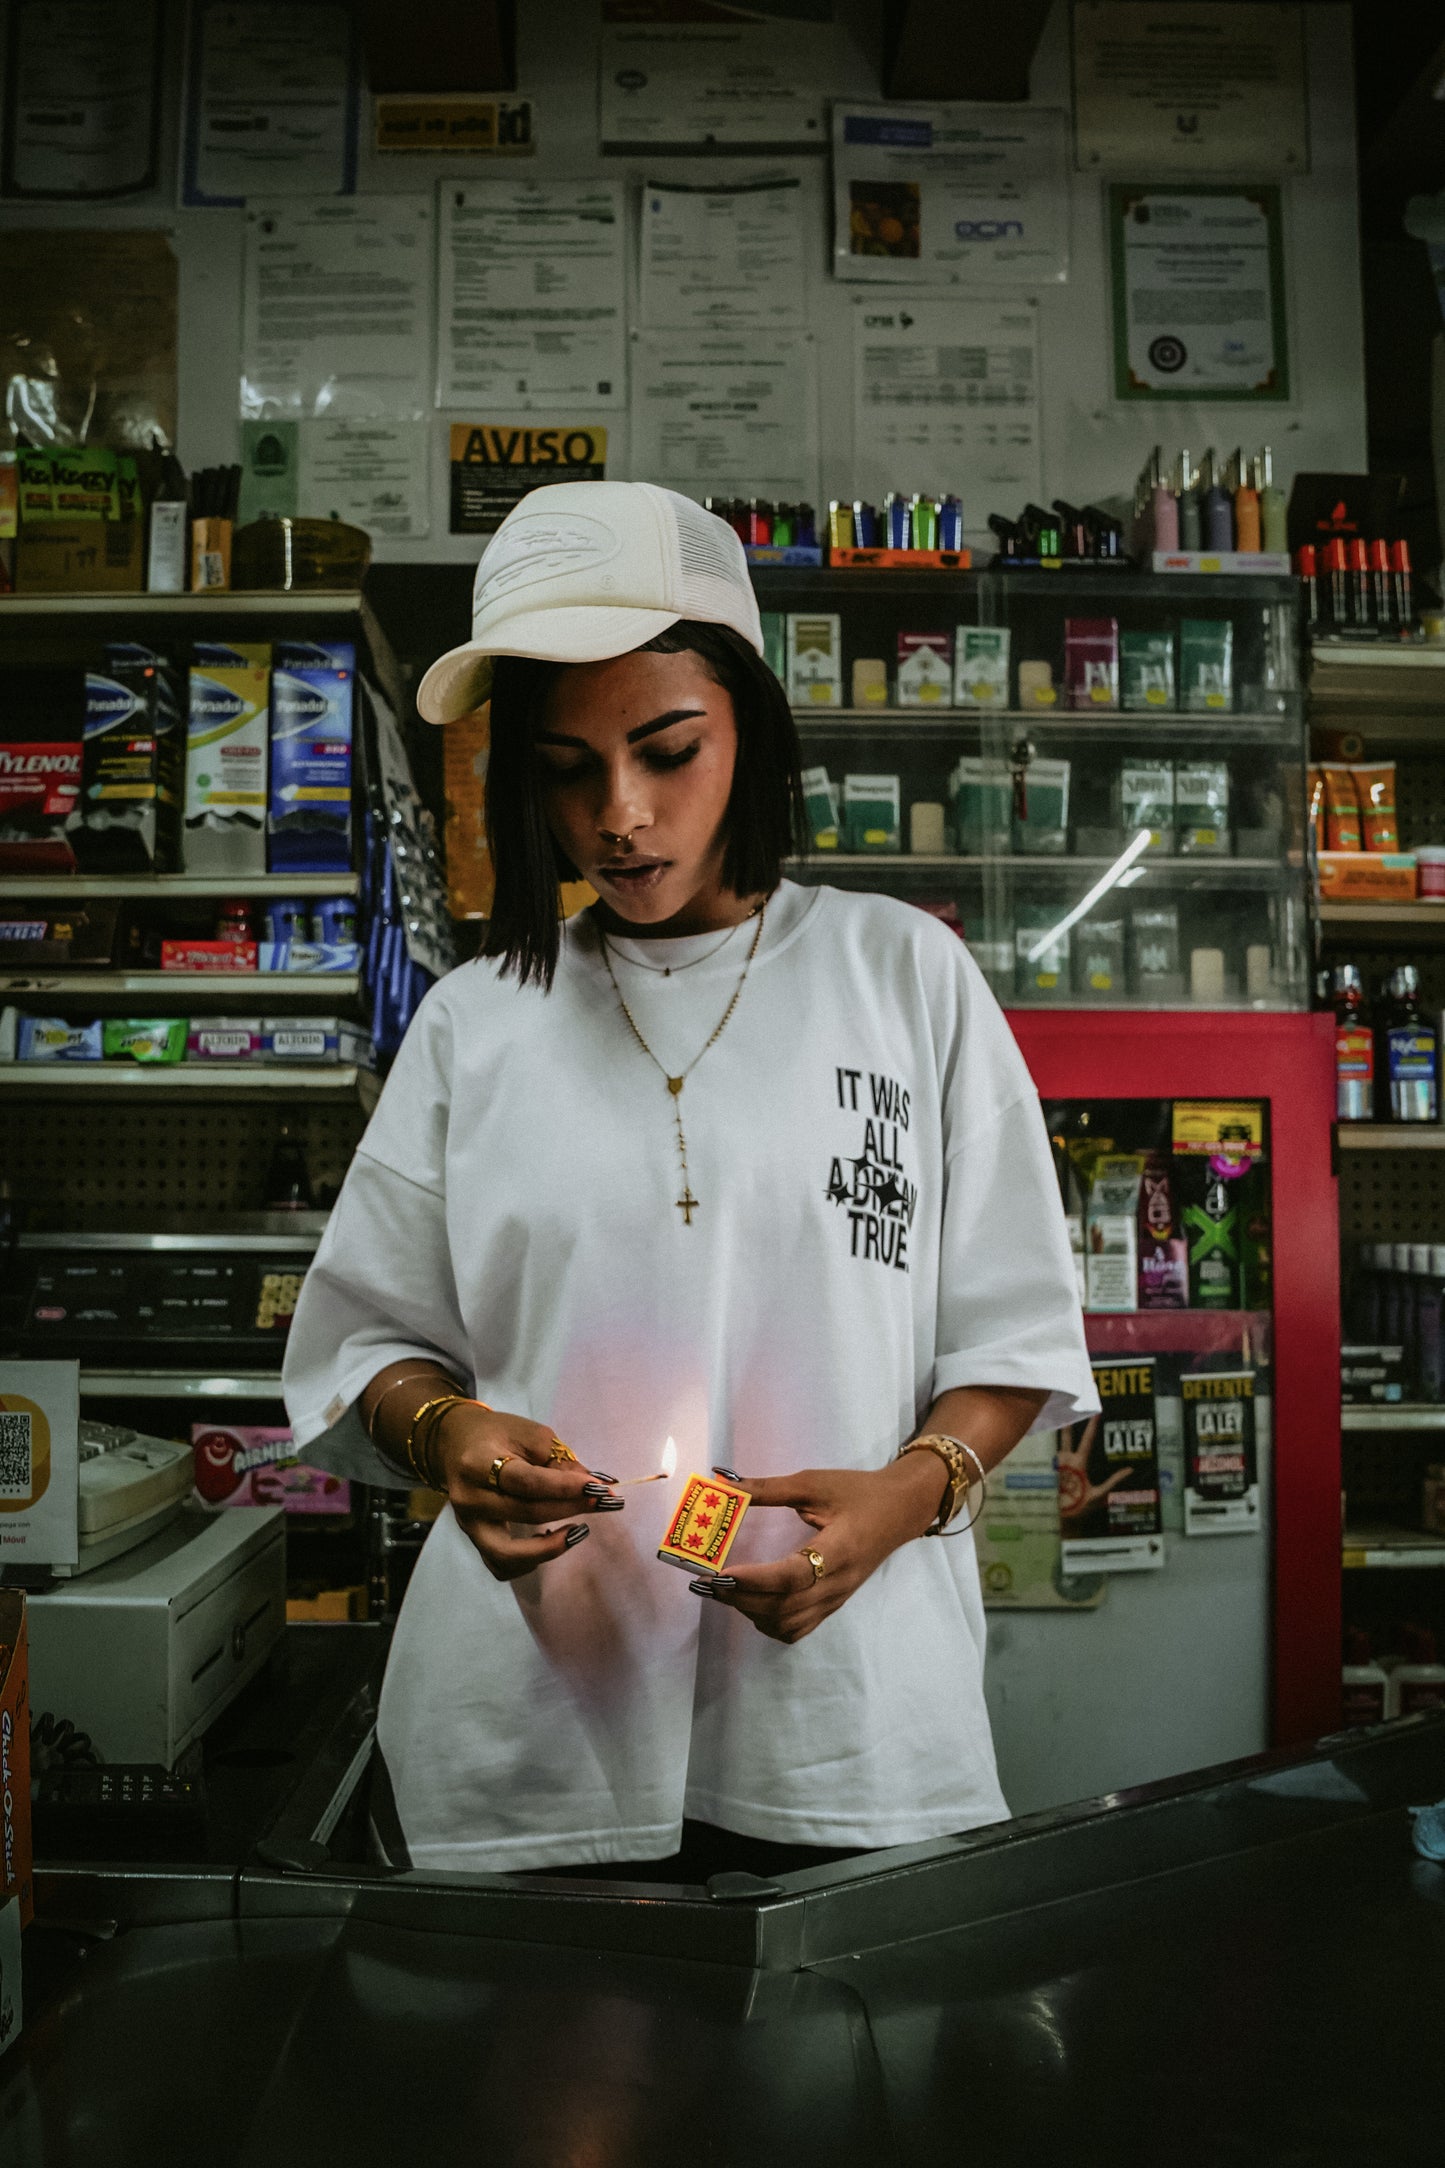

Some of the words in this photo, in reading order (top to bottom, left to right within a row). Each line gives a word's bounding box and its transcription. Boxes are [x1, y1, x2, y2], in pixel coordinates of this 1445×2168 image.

[463, 429, 596, 464] AVISO
[87, 699, 132, 712] Panadol
[192, 699, 243, 712] Panadol
[836, 1067, 861, 1111] IT
[869, 1072, 911, 1132] WAS
[864, 1117, 904, 1172] ALL
[1182, 1377, 1255, 1399] DETENTE
[1197, 1411, 1217, 1435] LA
[1217, 1411, 1243, 1434] LEY
[1104, 1428, 1125, 1454] LA
[1125, 1427, 1153, 1453] LEY
[721, 1496, 738, 1530] THREE
[3, 1535, 27, 1545] Móvil
[705, 1529, 727, 1559] STARS
[2, 1710, 17, 1888] Chick-O-Stick
